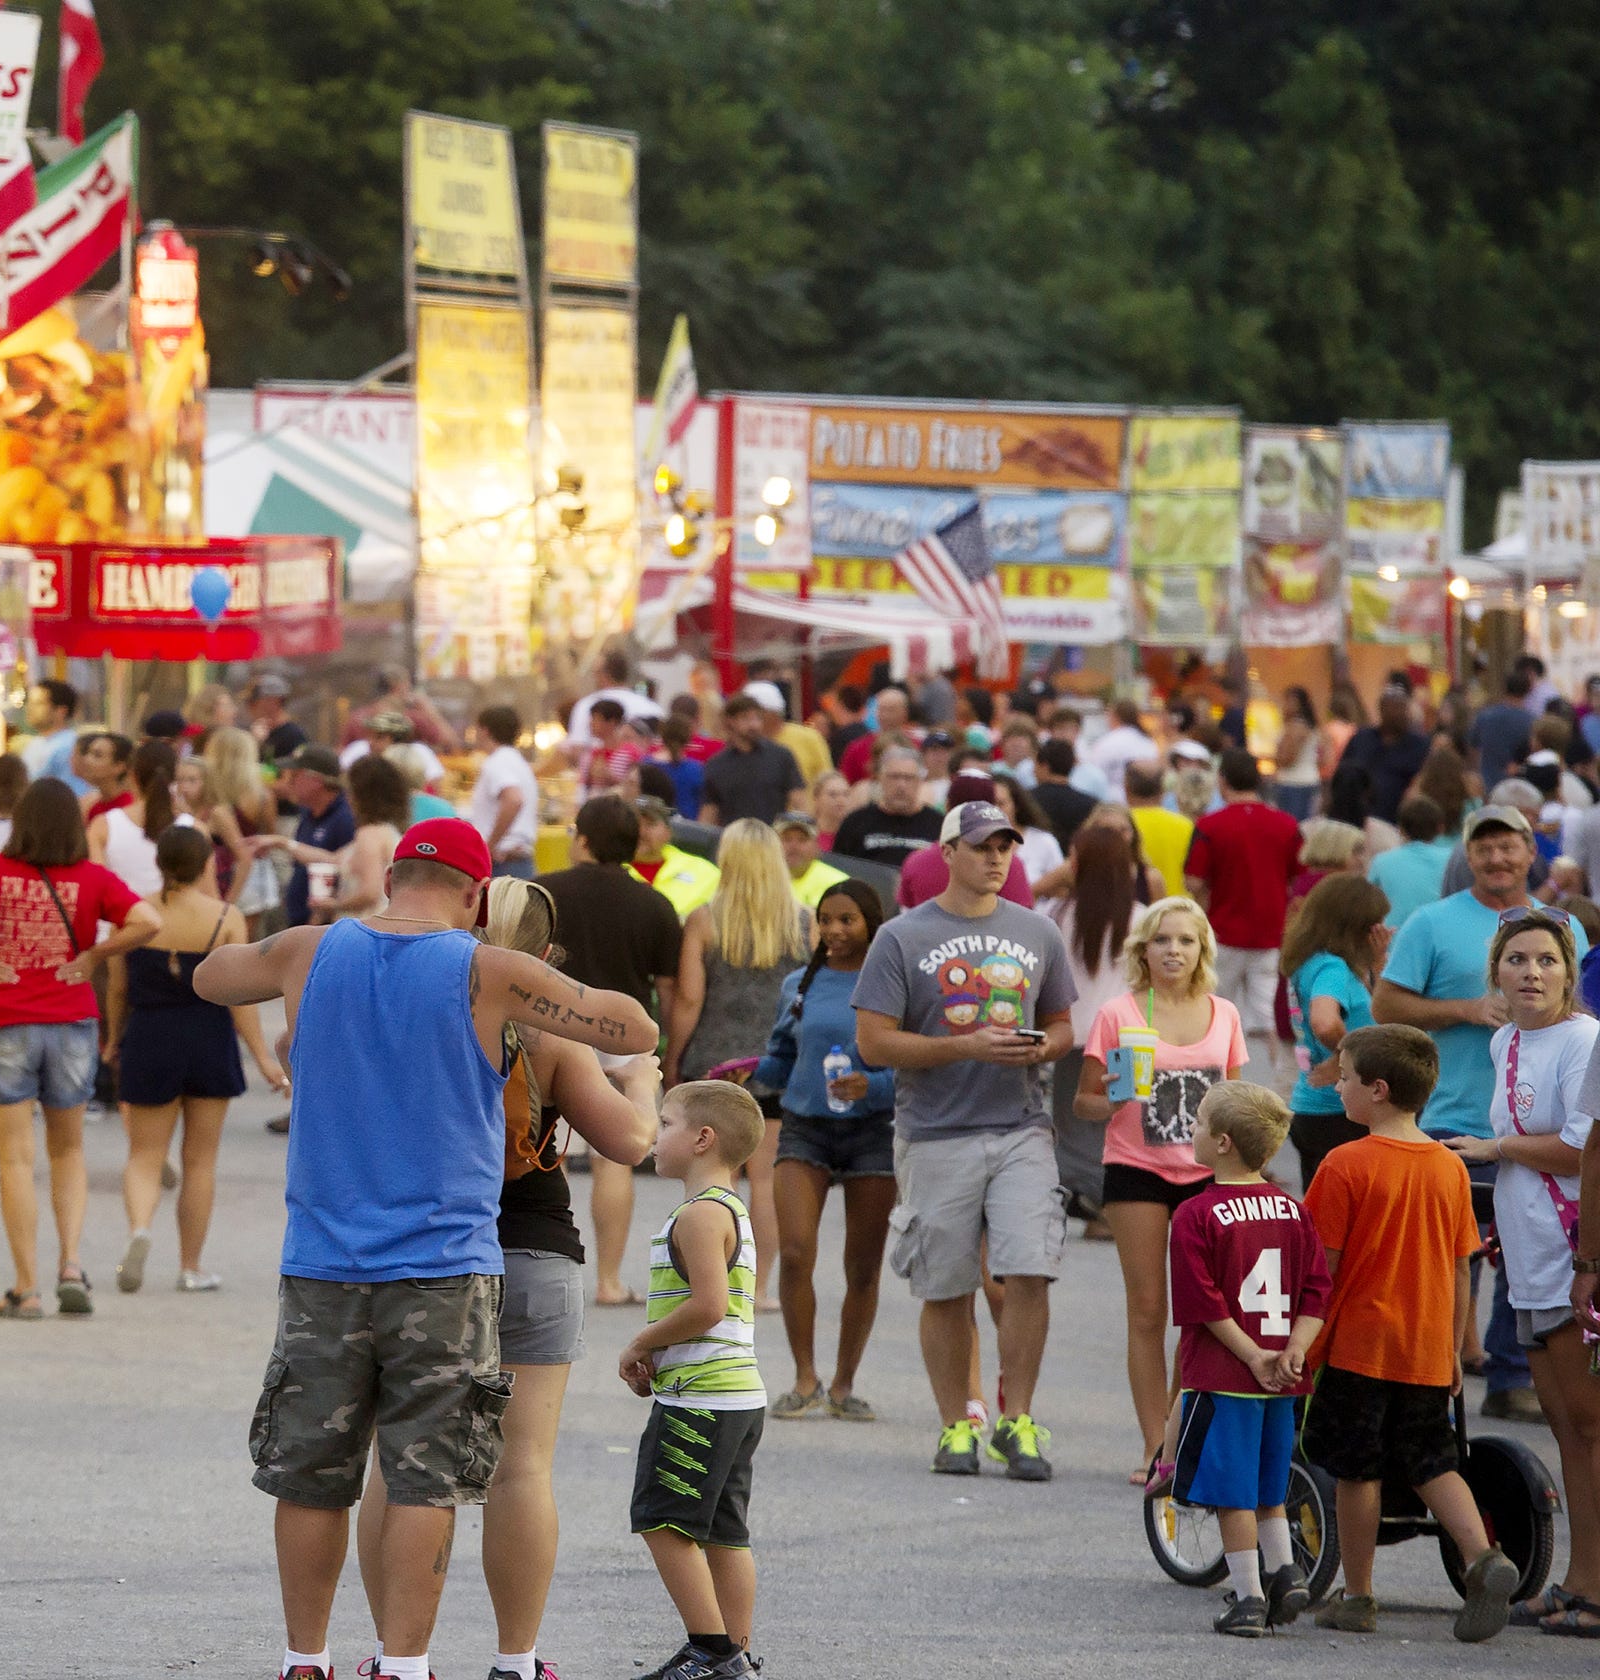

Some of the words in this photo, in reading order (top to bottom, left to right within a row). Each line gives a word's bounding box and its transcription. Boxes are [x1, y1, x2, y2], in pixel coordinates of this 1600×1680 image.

[918, 934, 983, 976] SOUTH
[986, 935, 1039, 971] PARK
[1237, 1247, 1291, 1337] 4
